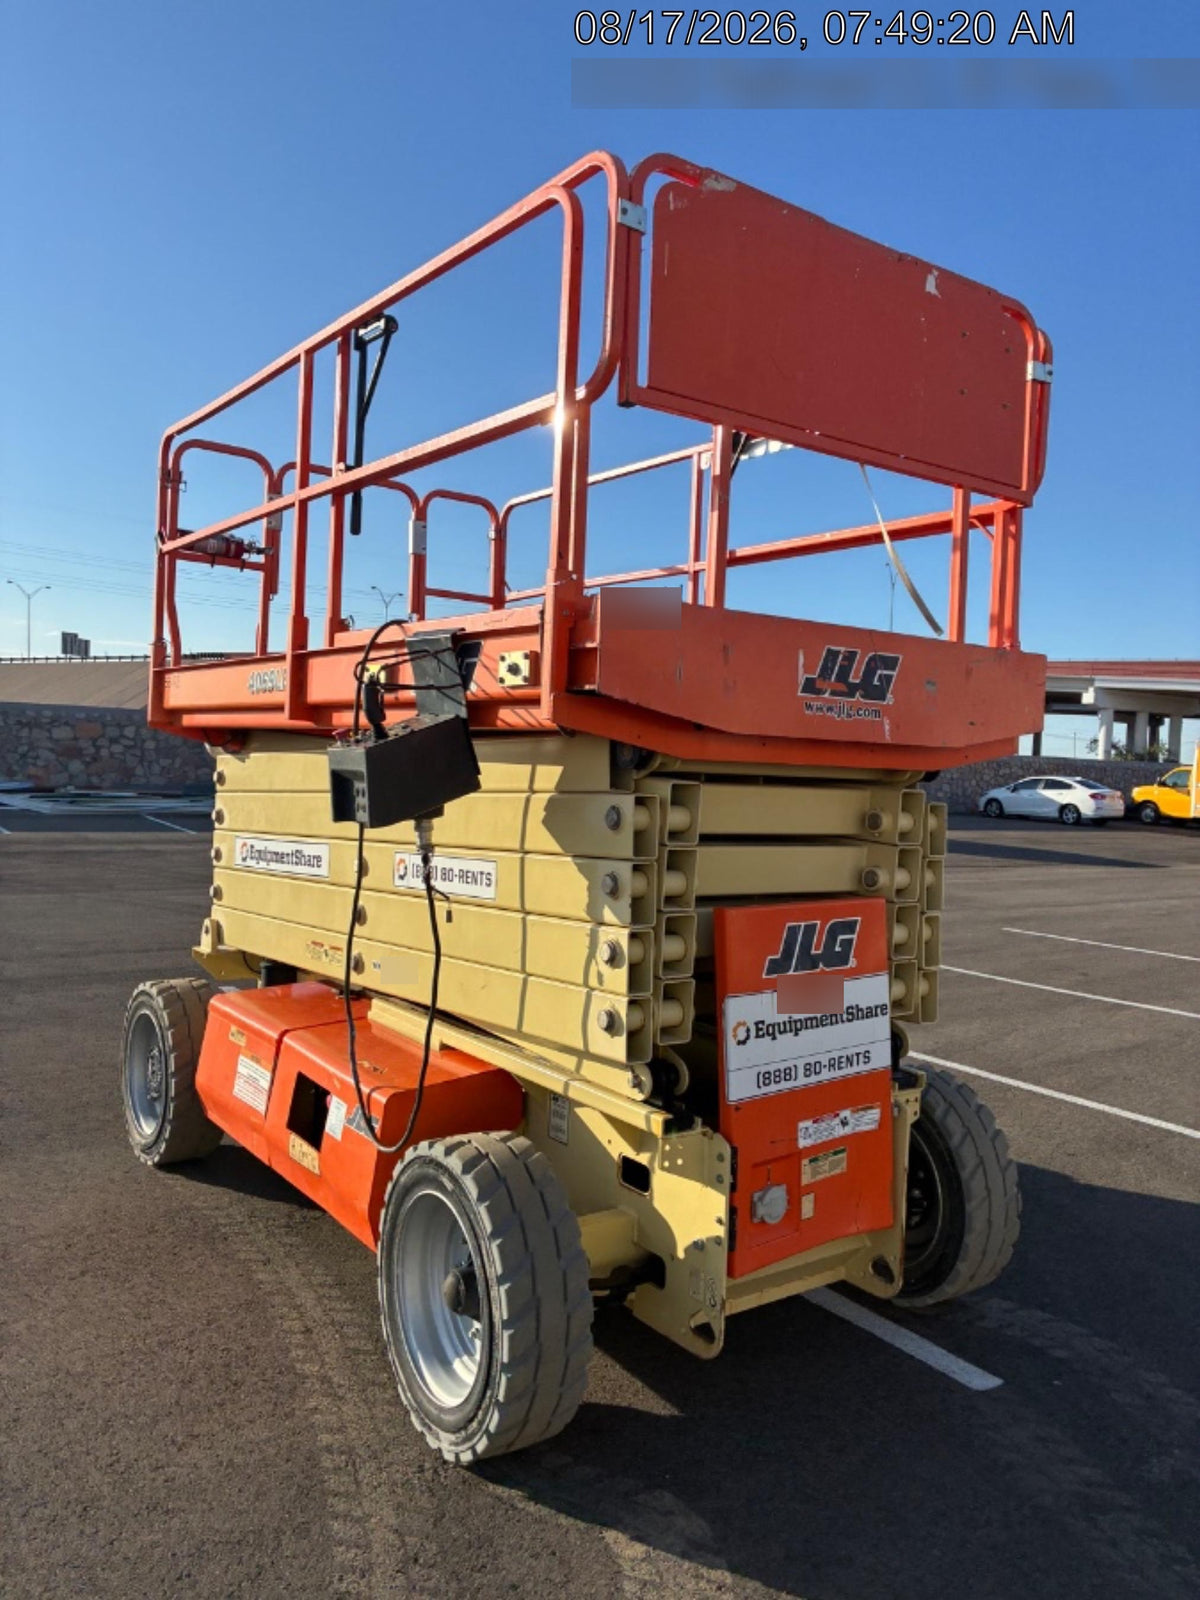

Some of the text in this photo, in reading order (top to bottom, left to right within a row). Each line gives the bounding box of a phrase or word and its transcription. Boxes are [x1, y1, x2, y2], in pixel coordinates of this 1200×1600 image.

[798, 645, 903, 704] JLG
[804, 701, 882, 720] www.jlg.com
[249, 843, 323, 869] EquipmentShare
[411, 862, 493, 888] (88) 80-RENTS
[762, 917, 861, 978] JLG
[753, 1002, 889, 1041] EquipmentShare
[756, 1050, 871, 1089] (888) 80-RENTS
